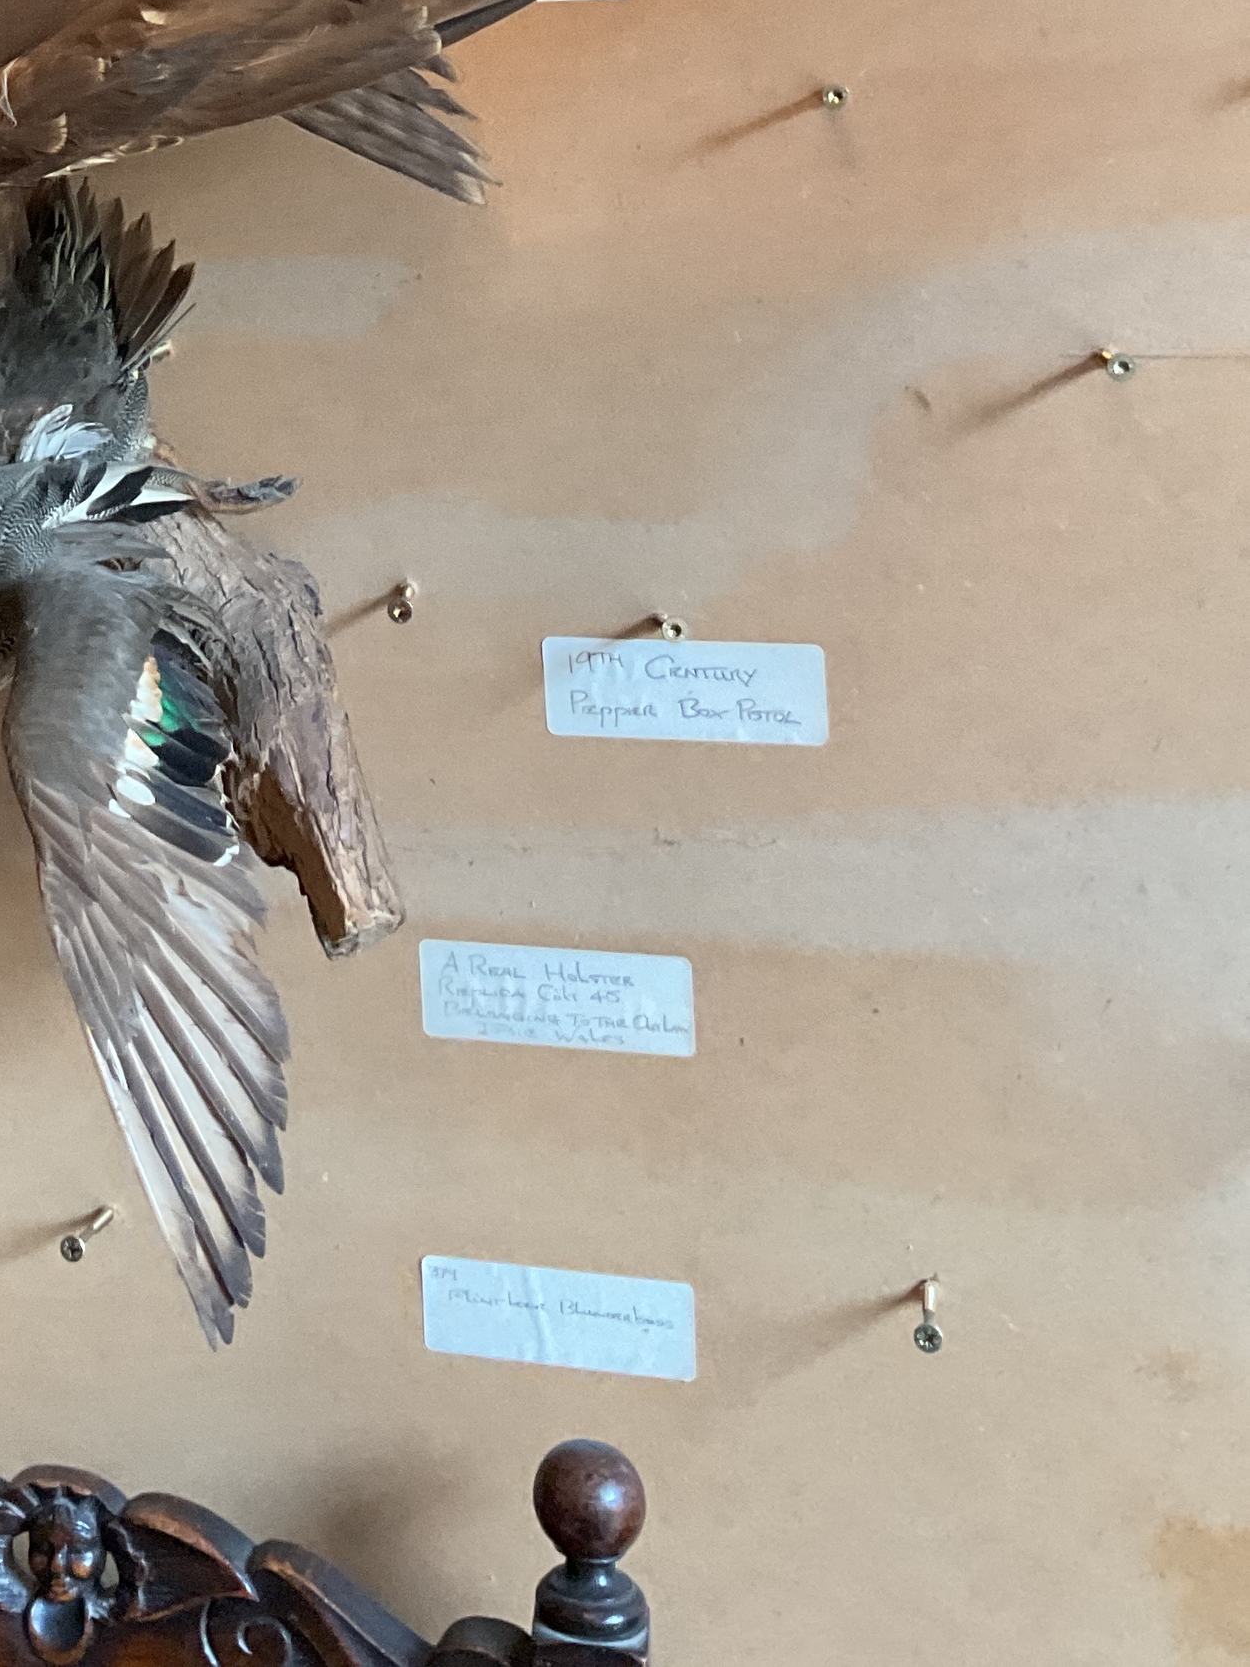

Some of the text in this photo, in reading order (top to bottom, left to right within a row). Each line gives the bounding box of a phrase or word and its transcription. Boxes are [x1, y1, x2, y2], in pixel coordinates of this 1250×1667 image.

[569, 651, 757, 686] 19TH CENTURY
[441, 952, 459, 974] A
[469, 954, 526, 978] REAL
